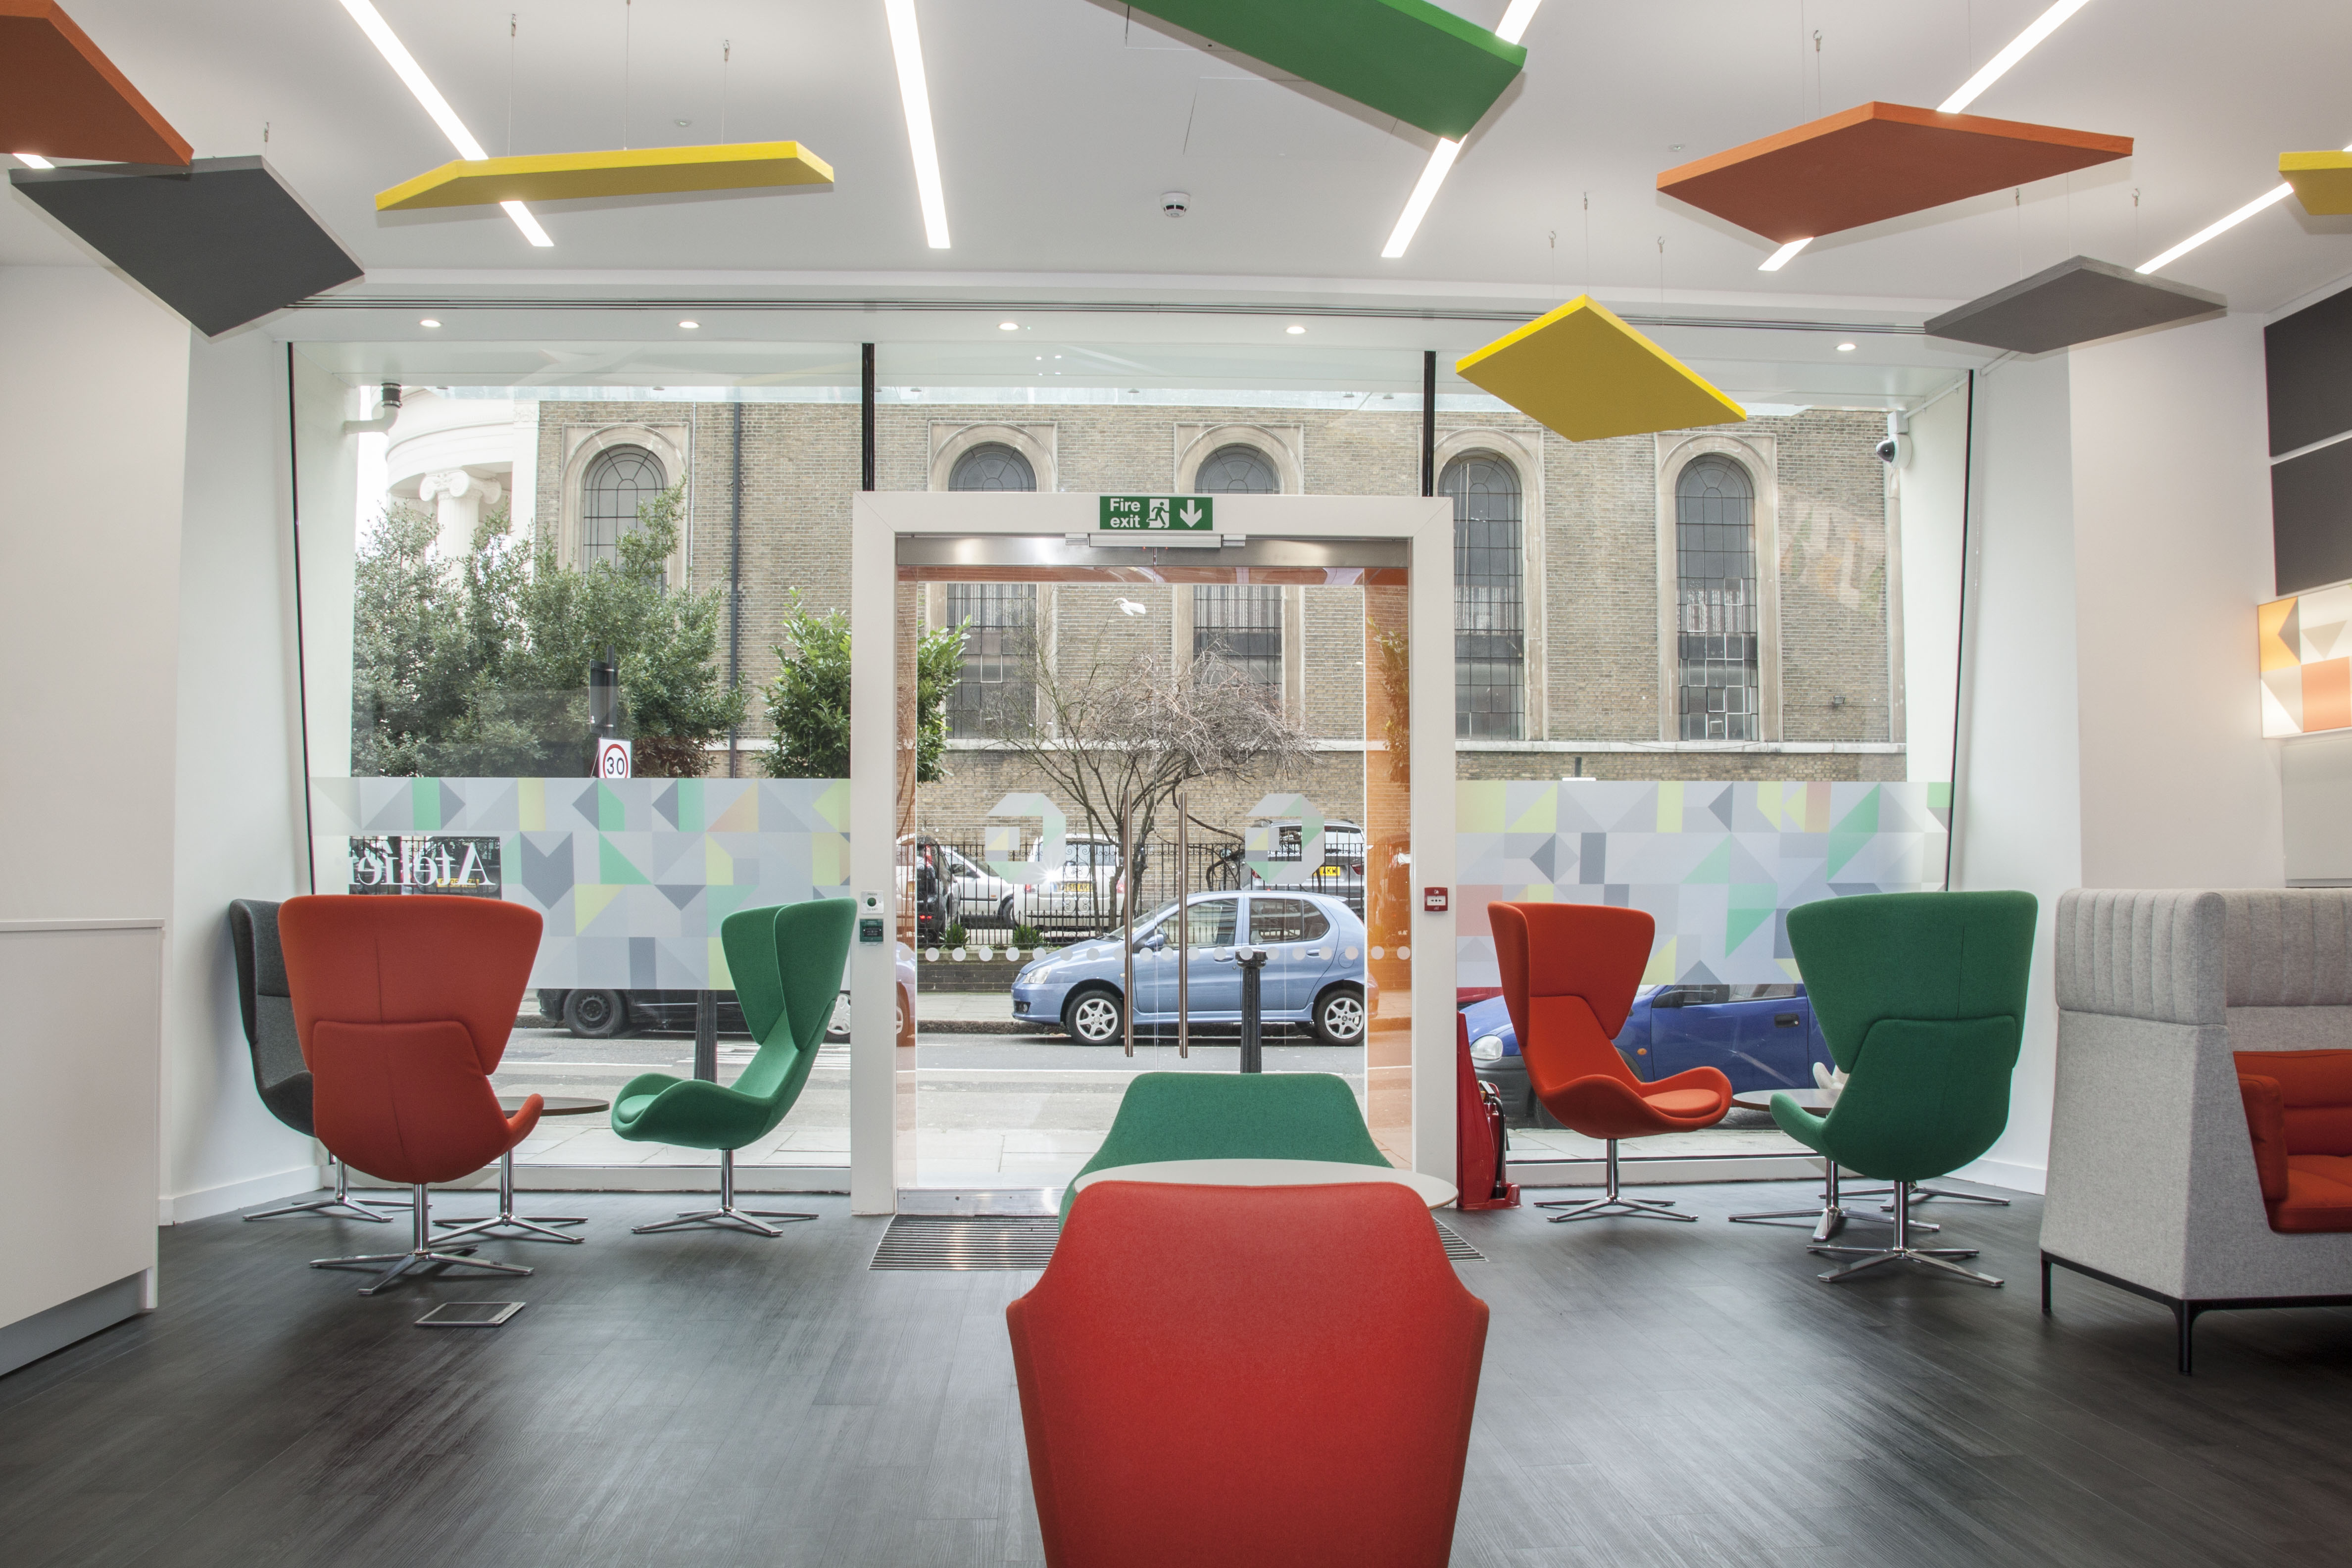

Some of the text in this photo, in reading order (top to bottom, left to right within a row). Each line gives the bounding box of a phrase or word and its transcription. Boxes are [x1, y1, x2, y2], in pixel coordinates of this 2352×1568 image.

[1110, 498, 1140, 512] Fire
[1110, 514, 1140, 528] exit
[607, 756, 624, 775] 30
